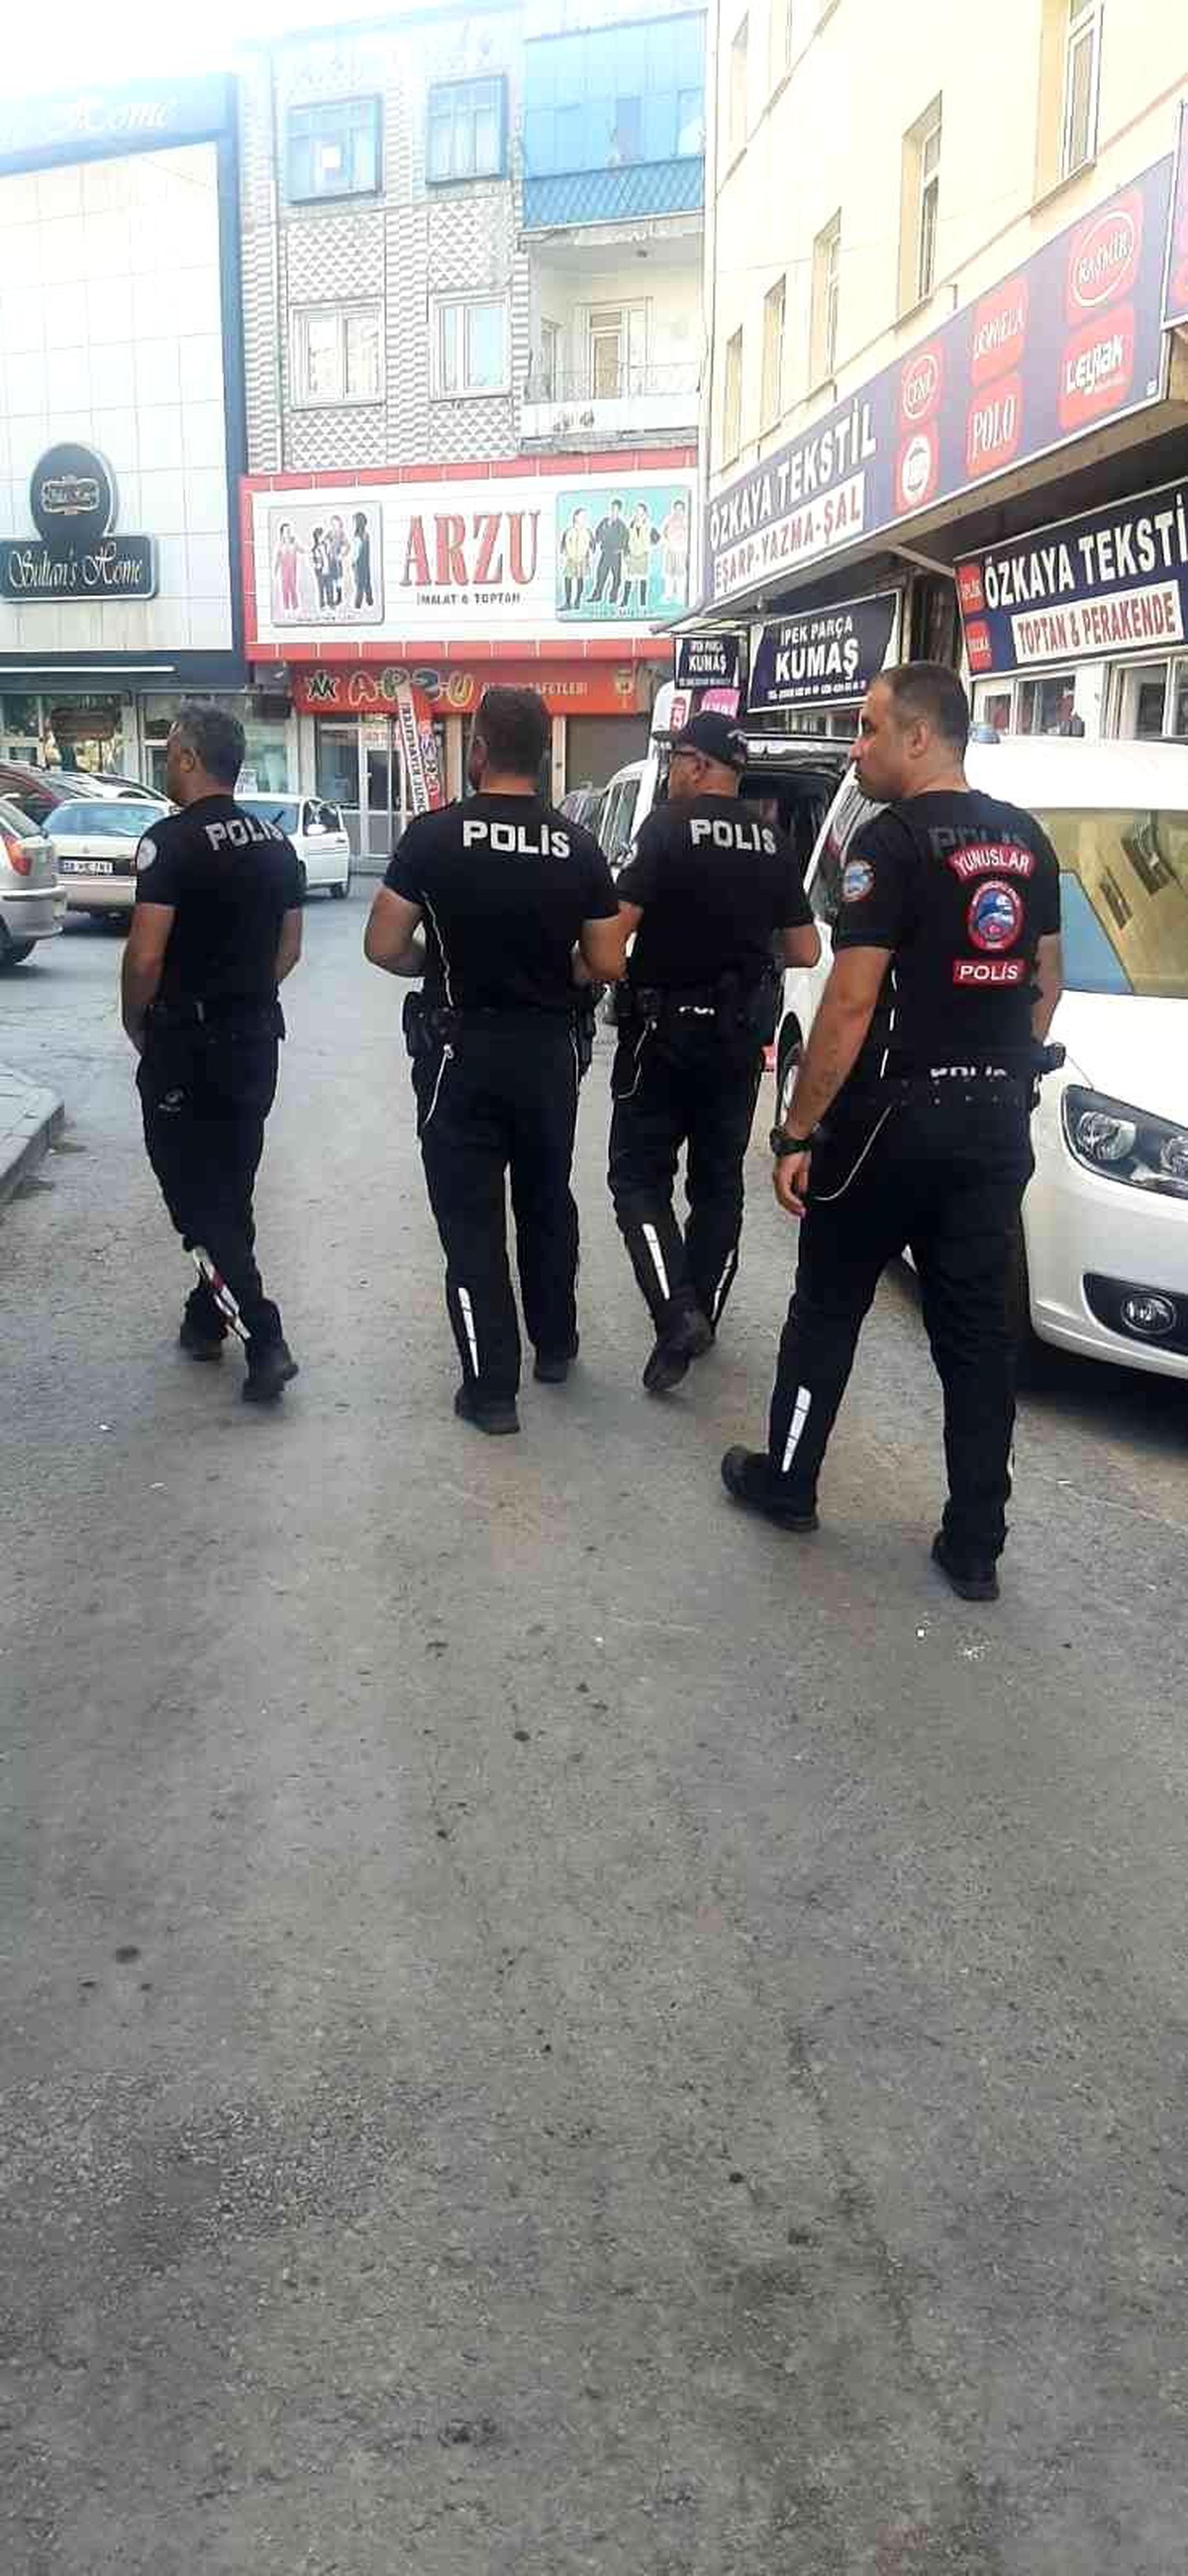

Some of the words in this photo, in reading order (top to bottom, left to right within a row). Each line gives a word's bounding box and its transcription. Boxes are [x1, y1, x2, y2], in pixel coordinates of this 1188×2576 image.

[972, 393, 1016, 463] POLO
[710, 474, 772, 551] ÖZKAYA
[777, 398, 877, 511] TEKSTİL
[82, 541, 144, 586] Home
[399, 510, 542, 587] ARZU
[984, 544, 1075, 610] ÖZKAYA
[780, 622, 809, 646] İPEK
[810, 615, 853, 641] PARÇA
[1017, 615, 1067, 655] TOPTAN
[1068, 612, 1081, 647] &
[1081, 590, 1177, 644] PERAKENDE
[688, 653, 727, 675] KUMAŞ
[775, 638, 859, 683] KUMAŞ
[953, 848, 1031, 877] YUNUSLAR
[958, 961, 1020, 981] POLİS
